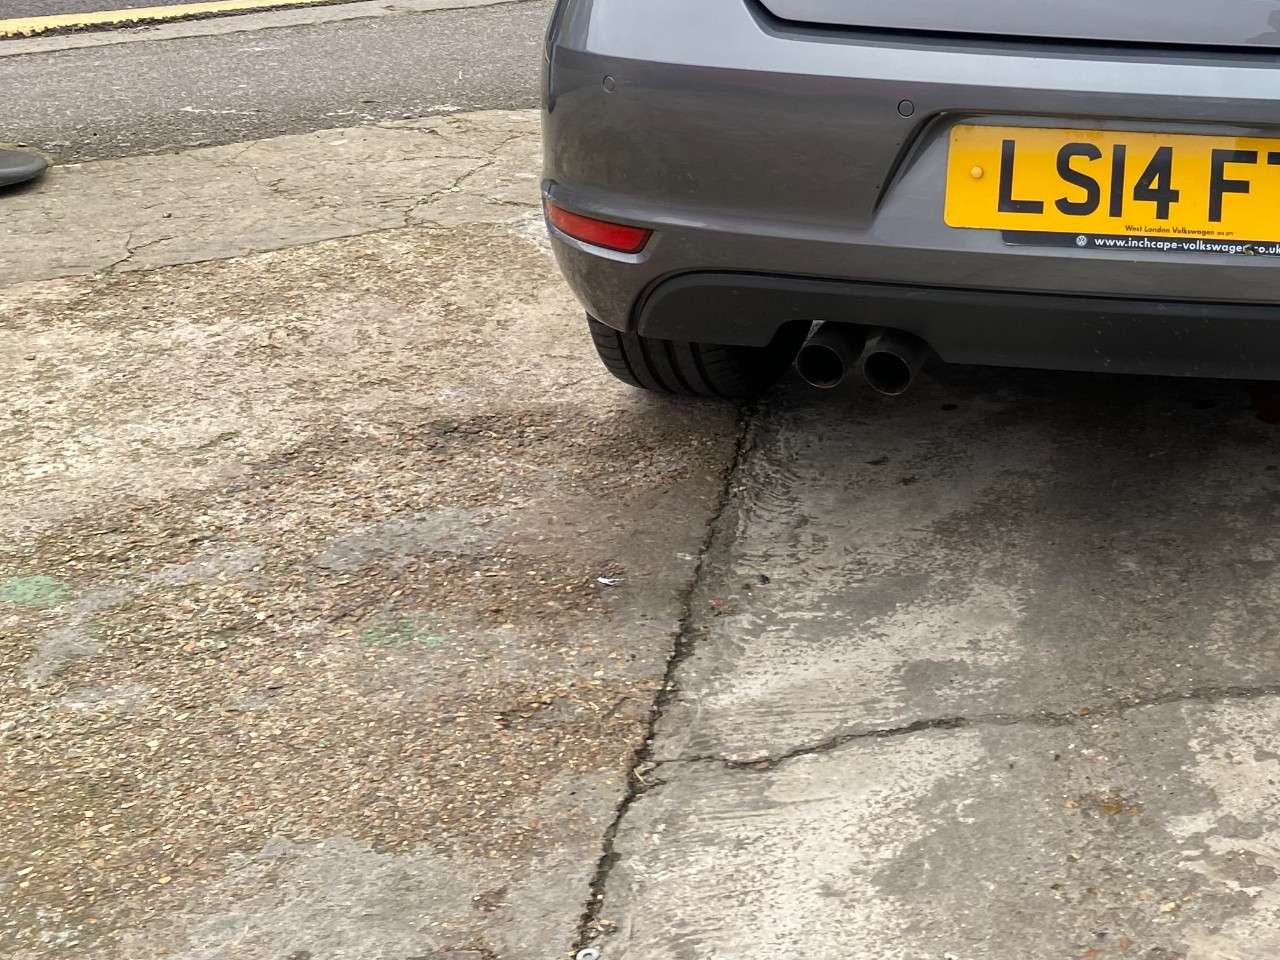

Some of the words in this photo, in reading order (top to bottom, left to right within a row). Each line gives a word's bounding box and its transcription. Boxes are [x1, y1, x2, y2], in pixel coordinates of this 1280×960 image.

[997, 138, 1180, 220] LS14
[1125, 224, 1142, 232] West
[1144, 225, 1170, 233] London
[1172, 226, 1214, 236] Volkswagen
